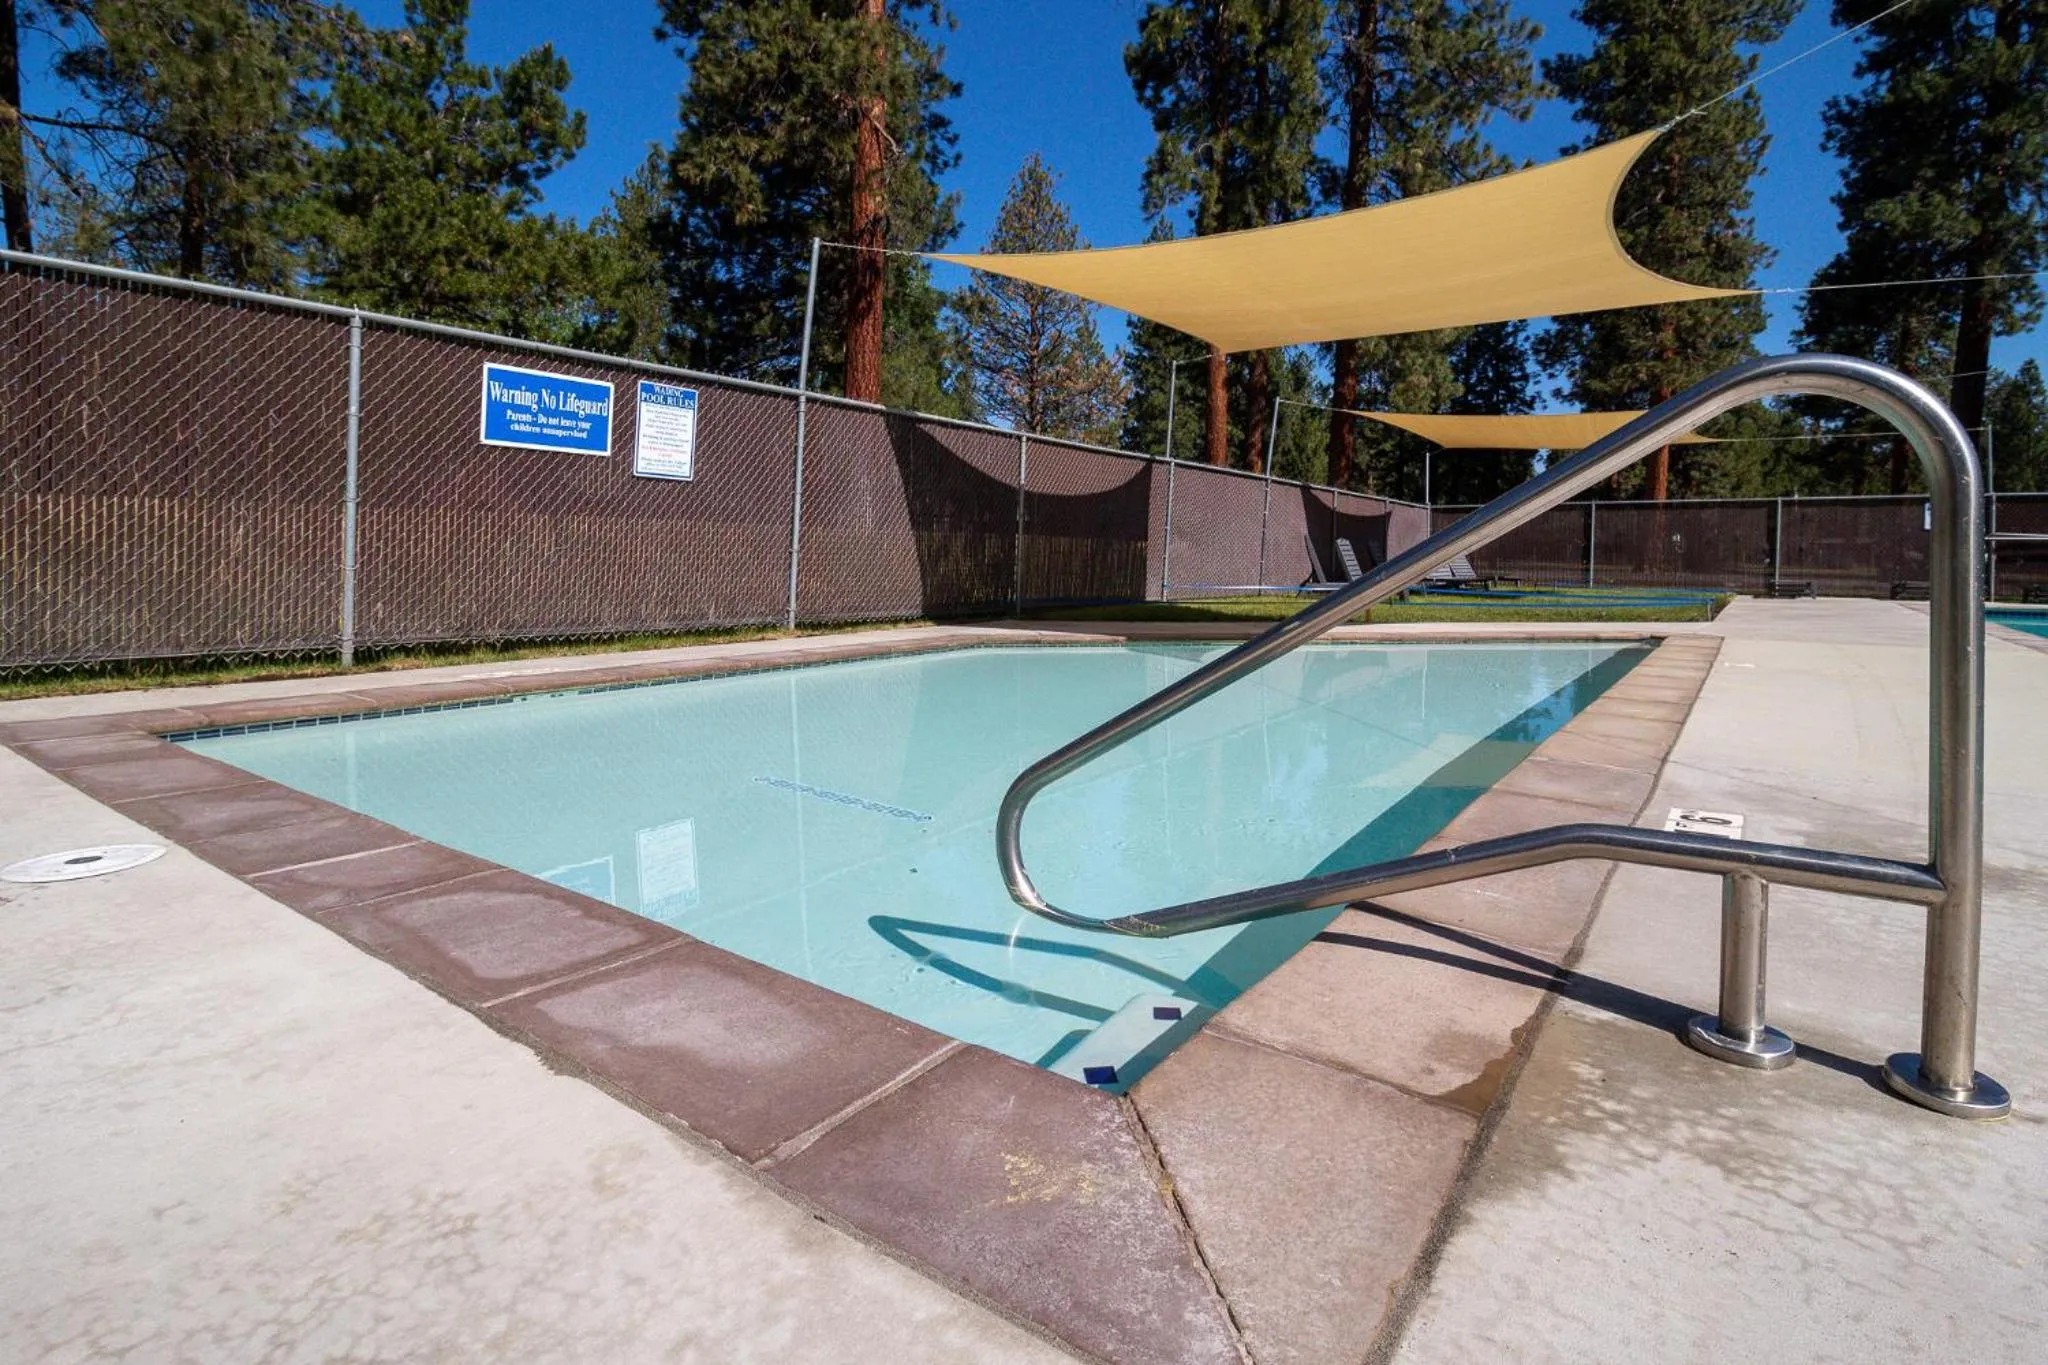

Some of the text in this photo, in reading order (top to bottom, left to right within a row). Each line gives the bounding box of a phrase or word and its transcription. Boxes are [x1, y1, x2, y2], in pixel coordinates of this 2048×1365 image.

[489, 380, 609, 418] Warning No Lifeguard
[641, 391, 666, 404] POOL
[667, 395, 695, 409] RULES
[510, 422, 588, 439] children unsupervised
[537, 413, 548, 424] Do
[548, 416, 559, 425] not
[560, 417, 577, 428] leave
[577, 420, 592, 431] your
